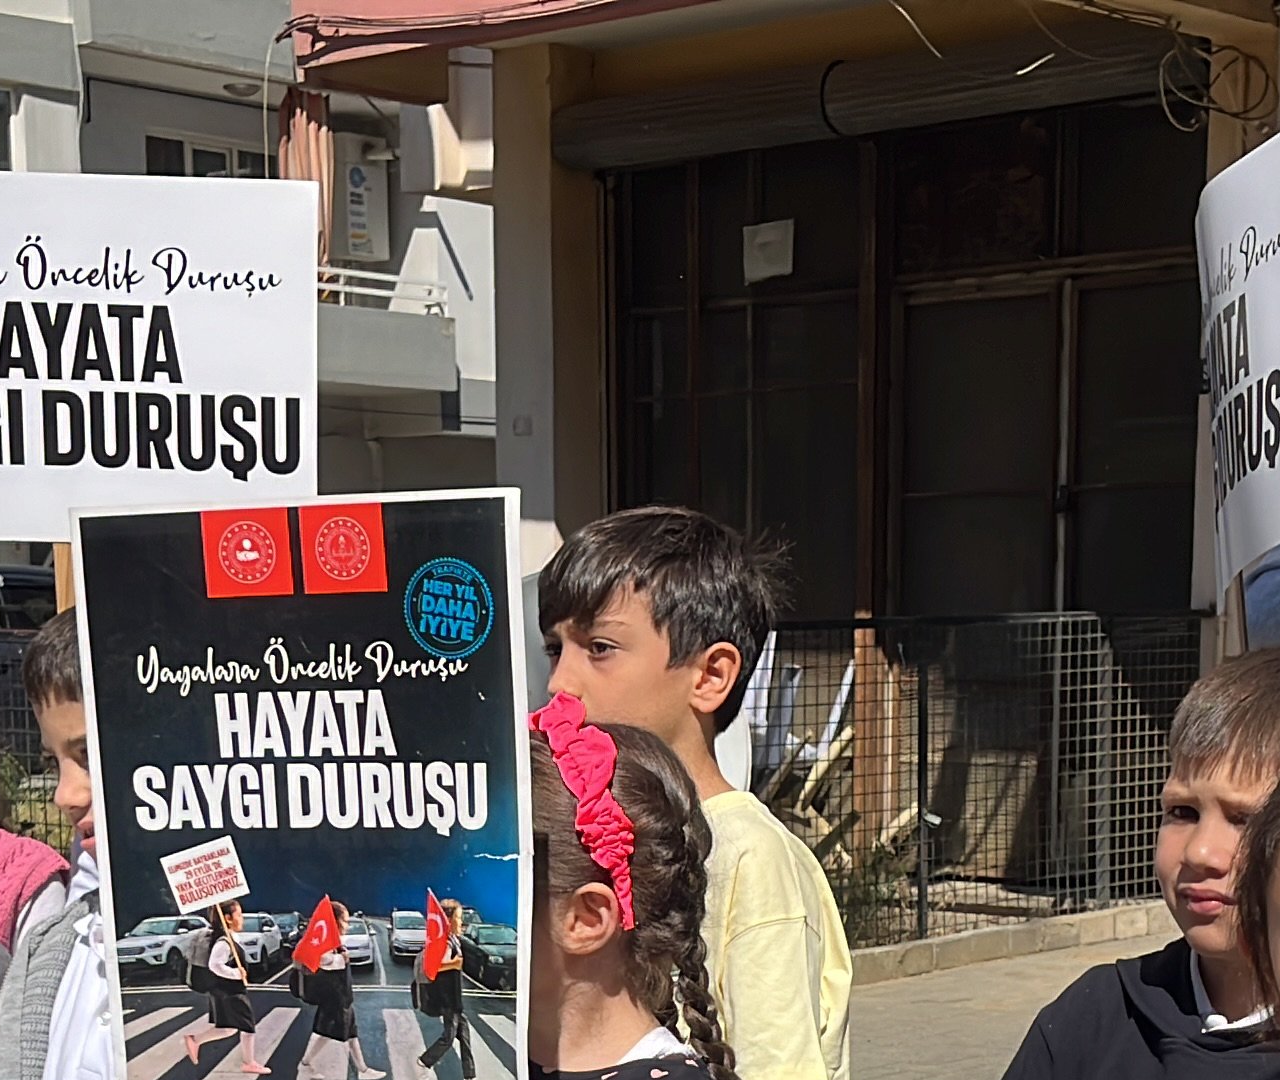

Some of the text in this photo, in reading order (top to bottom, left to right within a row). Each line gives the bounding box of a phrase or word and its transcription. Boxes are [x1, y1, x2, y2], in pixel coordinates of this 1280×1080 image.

[16, 235, 145, 294] Öncelik
[152, 246, 282, 299] Duruşu
[41, 390, 301, 482] DURUŞU
[421, 594, 476, 621] DAHA
[423, 578, 478, 601] HER YIL
[419, 612, 476, 642] İYİYE
[136, 637, 469, 697] Yayalara Öncelik Duruşu
[214, 688, 398, 759] HAYATA
[132, 760, 489, 837] SAYGI DURUŞU
